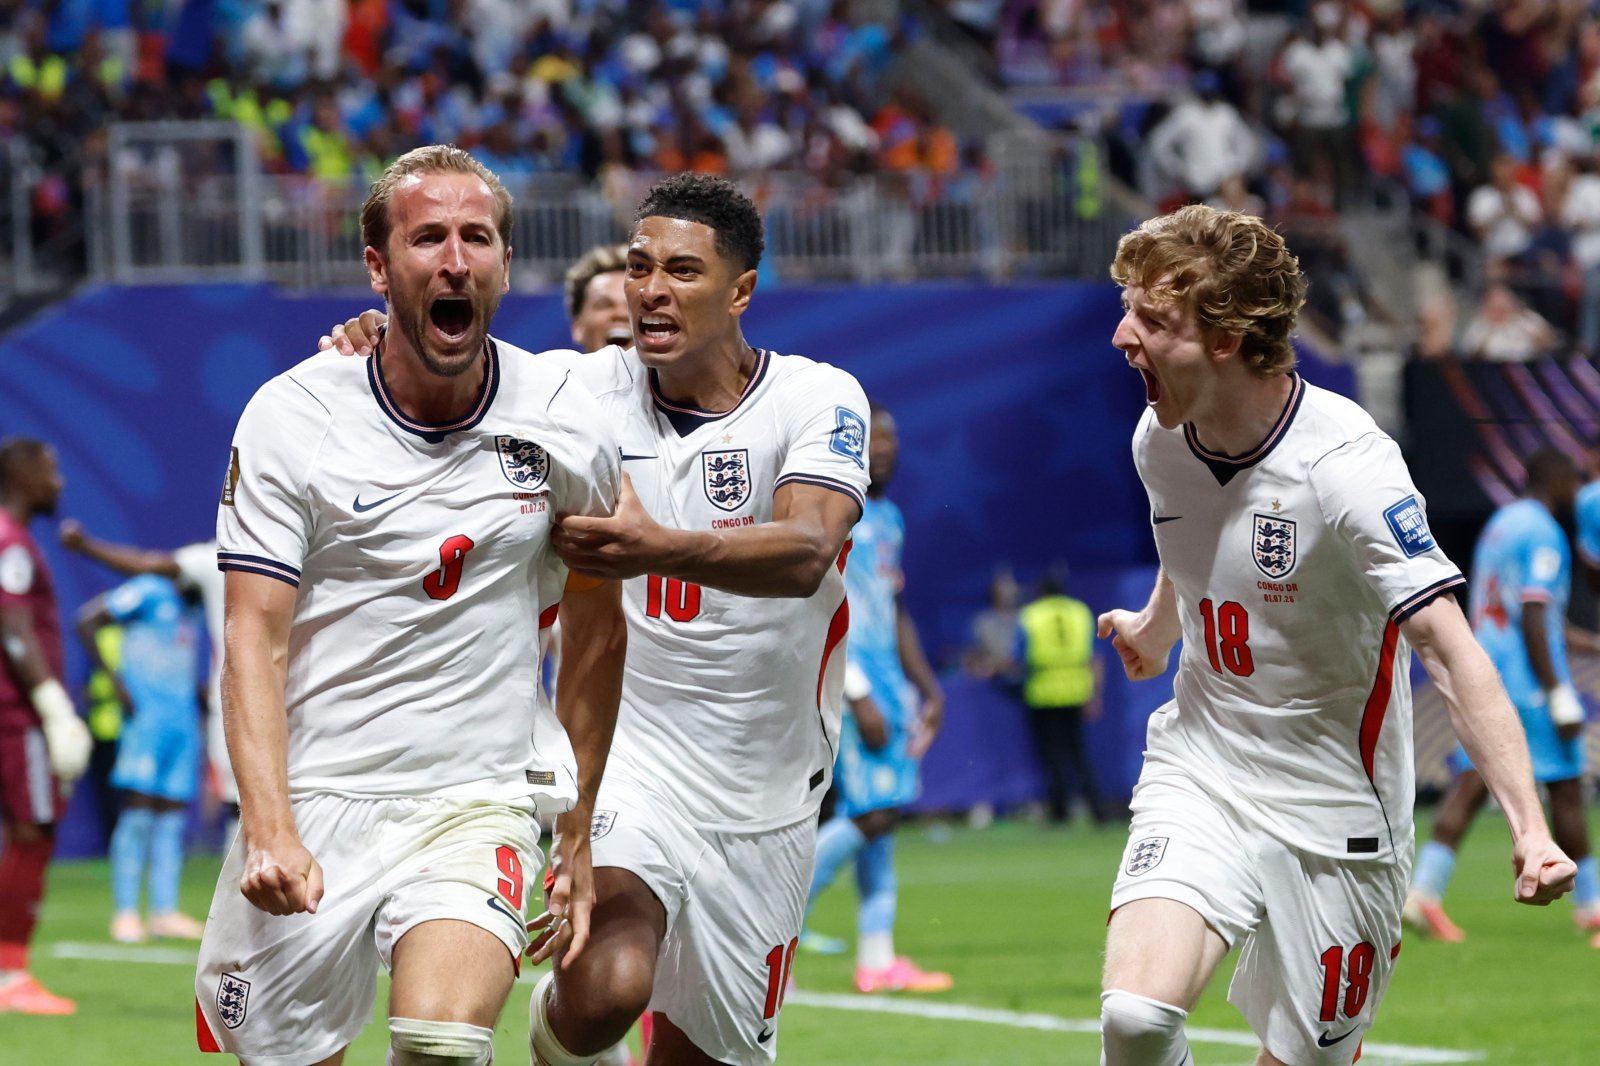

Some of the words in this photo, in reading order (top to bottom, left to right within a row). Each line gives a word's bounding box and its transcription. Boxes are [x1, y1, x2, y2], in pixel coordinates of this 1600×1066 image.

[520, 501, 546, 514] 01.07.26
[711, 518, 741, 529] CONGO
[742, 515, 755, 526] DR
[646, 573, 702, 623] 10
[1257, 581, 1285, 592] CONGO
[1285, 583, 1299, 592] DR
[1263, 594, 1295, 603] 01.07.26
[1199, 597, 1255, 678] 18
[495, 845, 524, 911] 9
[1319, 941, 1376, 1022] 18
